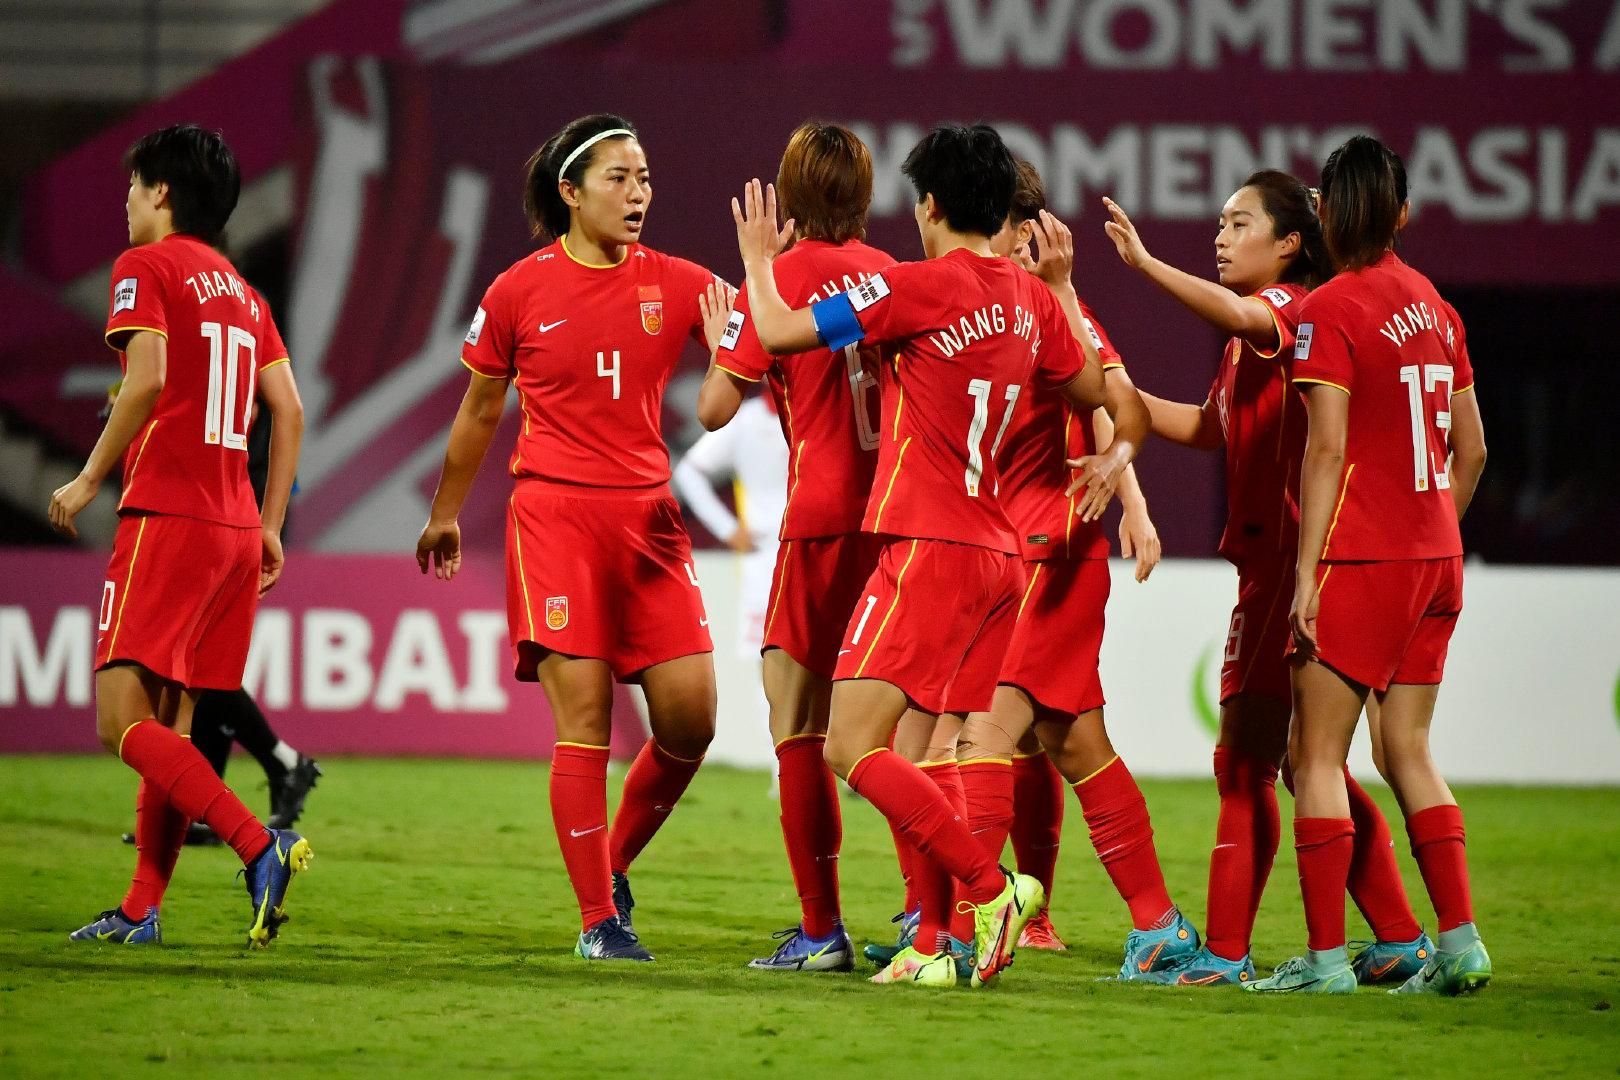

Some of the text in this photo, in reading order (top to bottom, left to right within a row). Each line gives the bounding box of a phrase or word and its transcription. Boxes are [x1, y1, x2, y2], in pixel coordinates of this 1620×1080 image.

[928, 303, 1006, 358] WANG
[1379, 301, 1433, 348] YANG
[201, 321, 256, 451] 10
[596, 350, 621, 400] 4
[1399, 363, 1454, 492] 13
